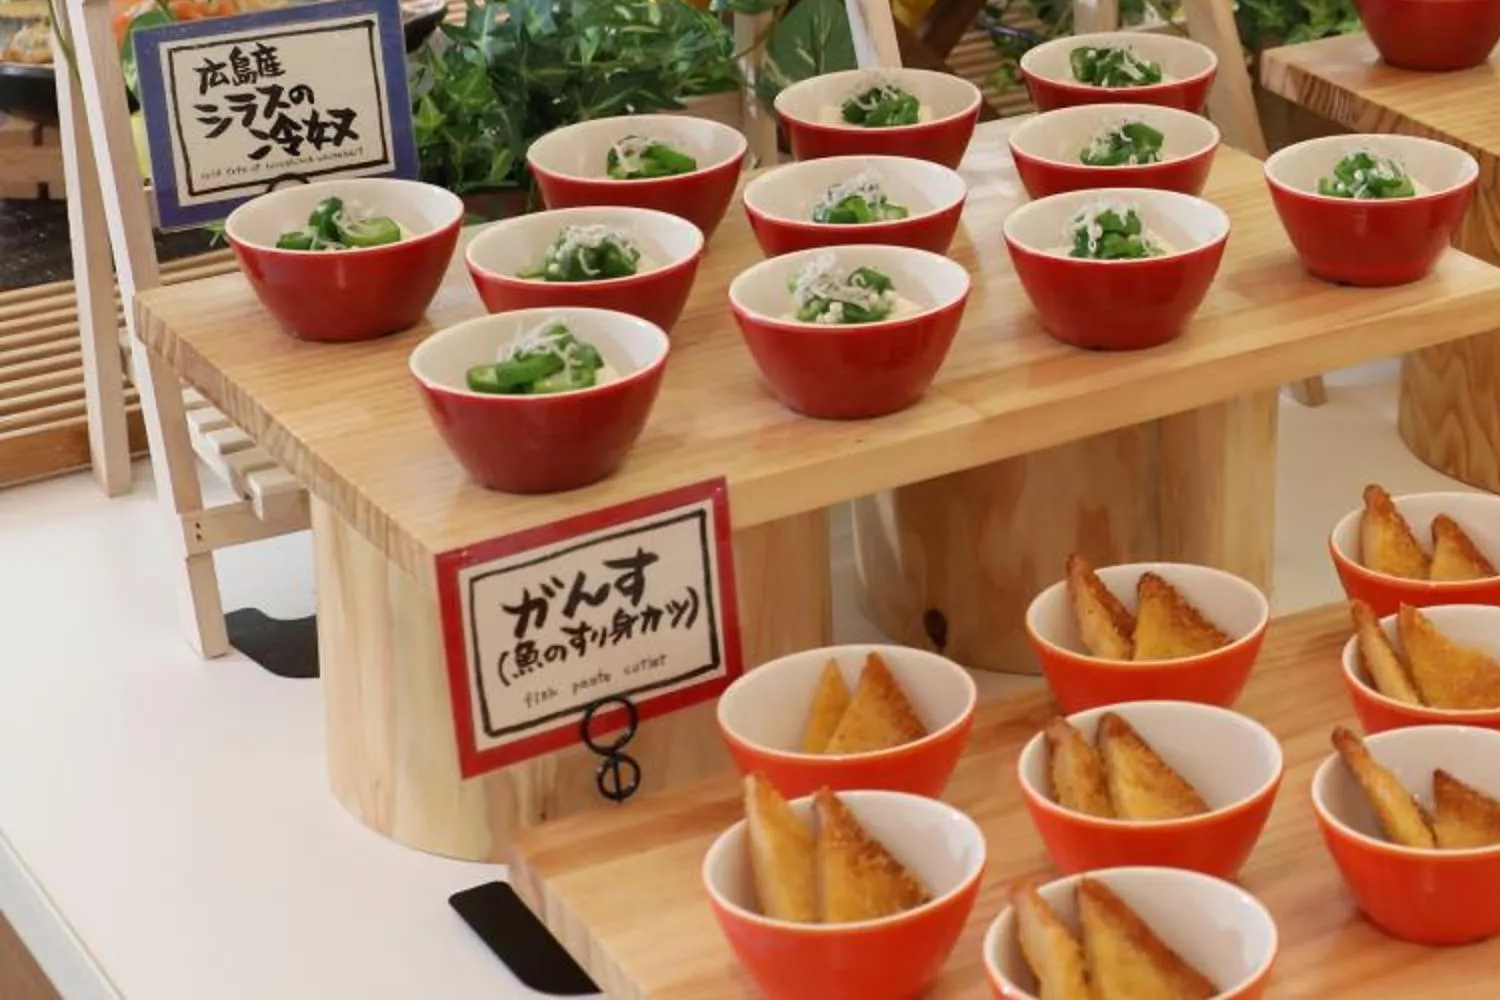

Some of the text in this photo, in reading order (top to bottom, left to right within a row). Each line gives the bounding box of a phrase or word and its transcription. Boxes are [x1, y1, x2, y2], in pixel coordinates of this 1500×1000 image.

[193, 42, 286, 95] 広島産
[193, 84, 315, 138] シラスの
[247, 107, 359, 160] 冷奴
[501, 546, 660, 639] がんす
